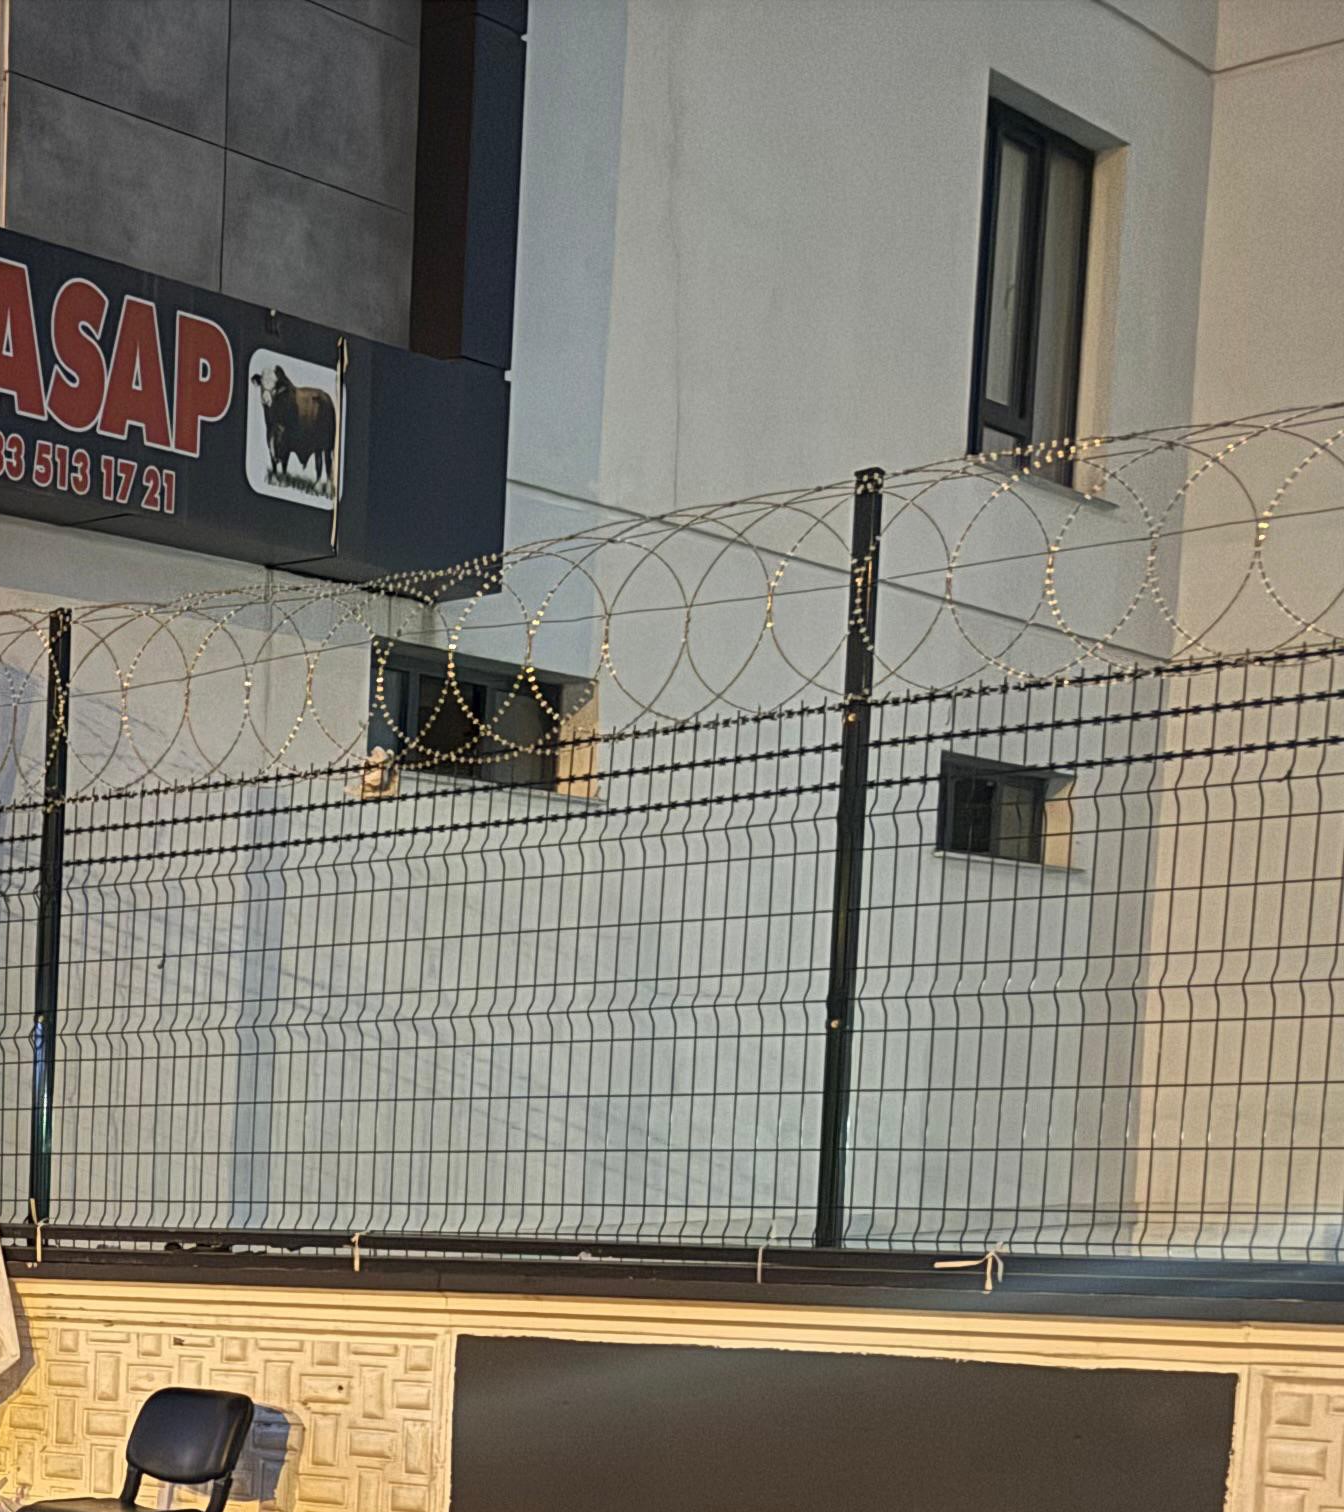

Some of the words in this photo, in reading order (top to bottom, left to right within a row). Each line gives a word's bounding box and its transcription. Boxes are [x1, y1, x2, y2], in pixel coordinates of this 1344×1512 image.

[32, 440, 90, 496] 513
[101, 455, 137, 504] 17
[141, 463, 177, 514] 21
